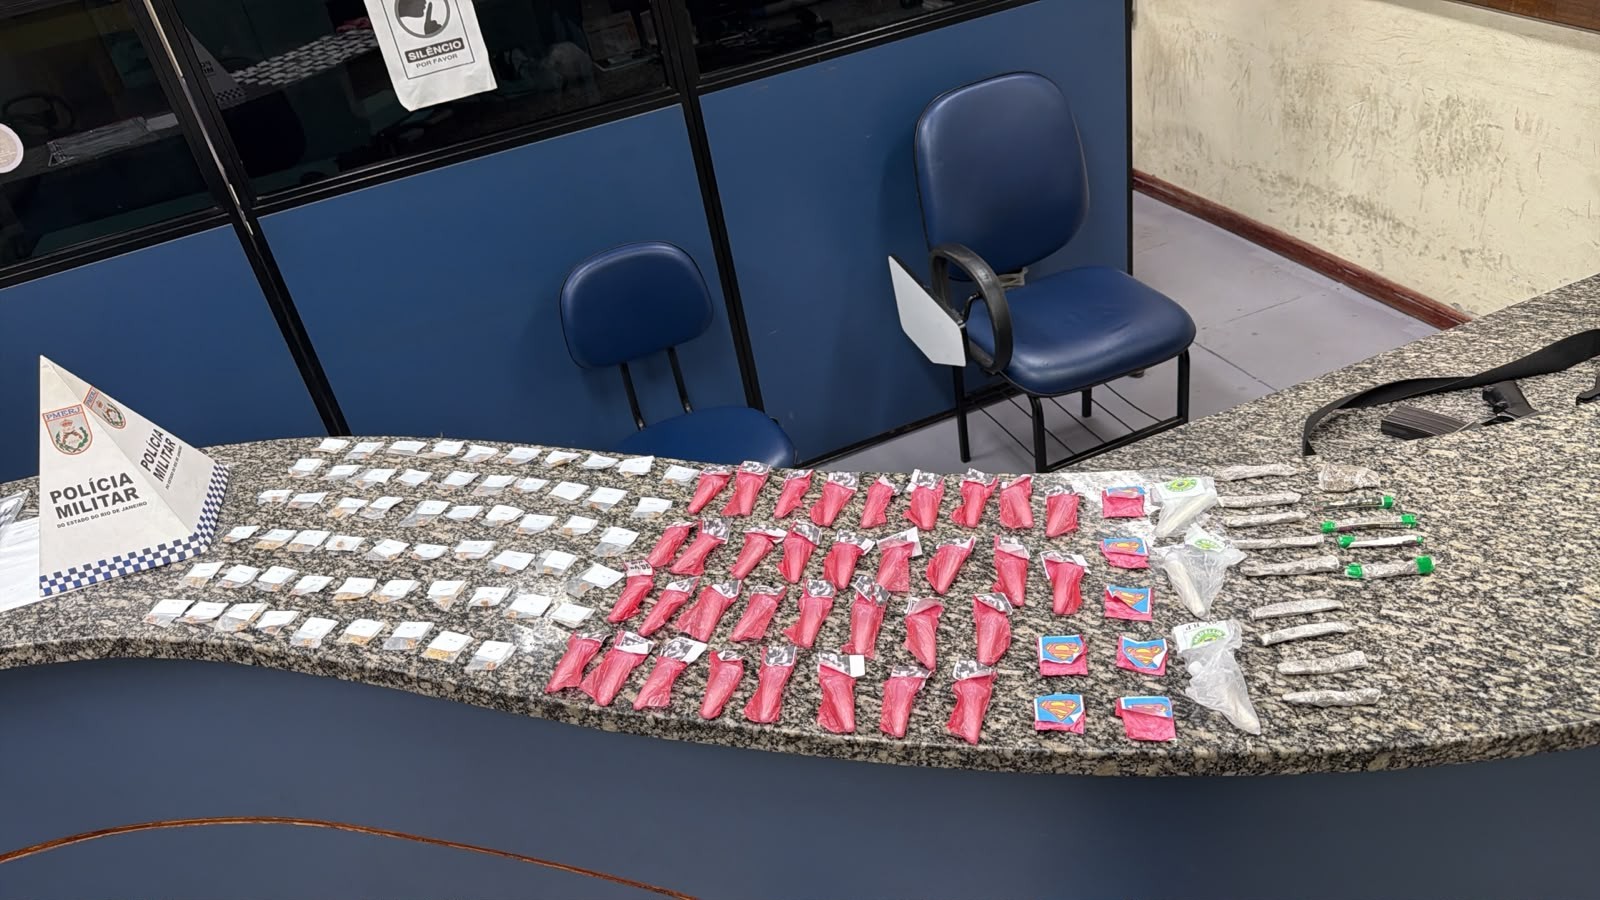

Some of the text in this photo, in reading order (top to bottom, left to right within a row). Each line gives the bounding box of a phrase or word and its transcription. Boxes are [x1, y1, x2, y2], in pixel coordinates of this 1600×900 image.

[408, 40, 462, 61] SILÊNCIO
[416, 53, 458, 69] POR FAVOR
[46, 407, 80, 420] PMERJ
[140, 428, 164, 472] POLÍCIA
[153, 437, 176, 482] MILITAR
[50, 472, 134, 504] POLÍCIA
[55, 487, 140, 519] MILITAR
[66, 516, 90, 526] ESTADO
[121, 501, 148, 512] JANEIRO
